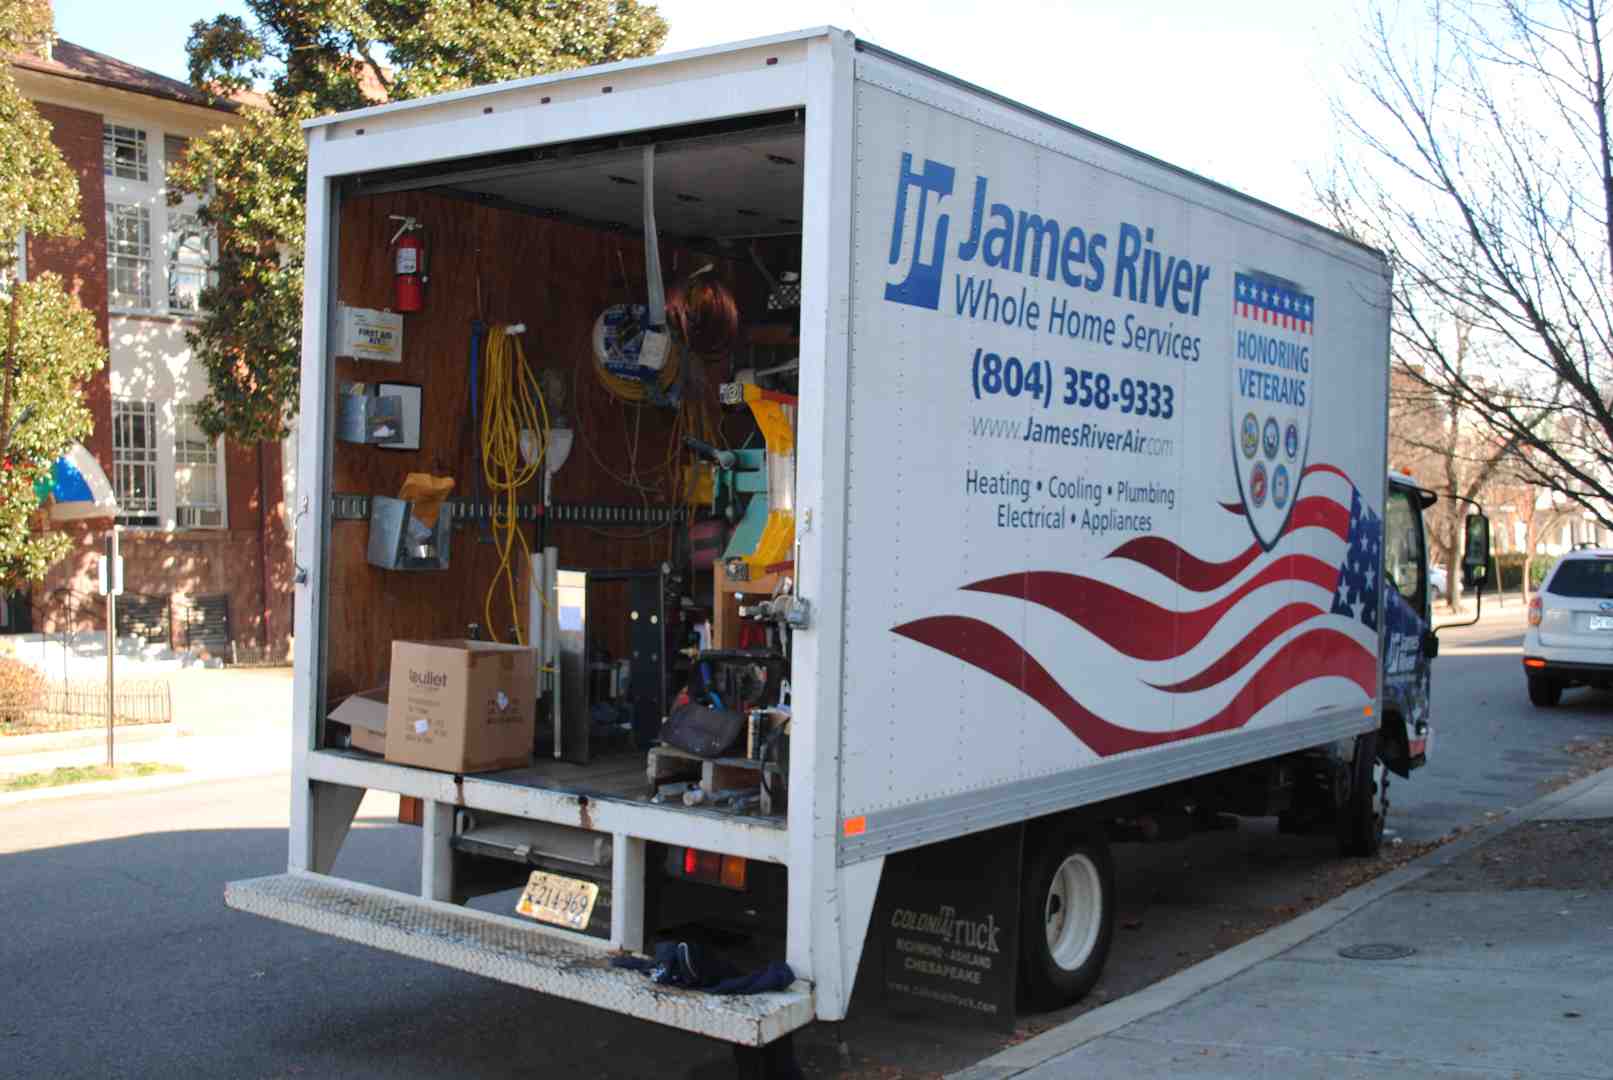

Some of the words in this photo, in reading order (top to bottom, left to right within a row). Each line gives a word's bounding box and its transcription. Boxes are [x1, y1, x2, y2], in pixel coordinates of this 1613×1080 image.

[958, 175, 1107, 293] James
[1113, 222, 1211, 316] River
[955, 272, 1041, 331] Whole
[1048, 296, 1116, 346] Home
[1121, 314, 1201, 362] Services
[1236, 329, 1310, 374] HONORING
[972, 347, 1052, 409] (804)
[1063, 366, 1175, 419] 358-9333
[1238, 367, 1307, 407] VETERANS
[971, 415, 1174, 457] www.JamesRiverAir.com
[965, 468, 1031, 502] Heating
[1048, 475, 1102, 507] Cooling
[1116, 480, 1176, 510] Plumbing
[997, 503, 1066, 530] Electrical
[1079, 507, 1153, 536] Appliances
